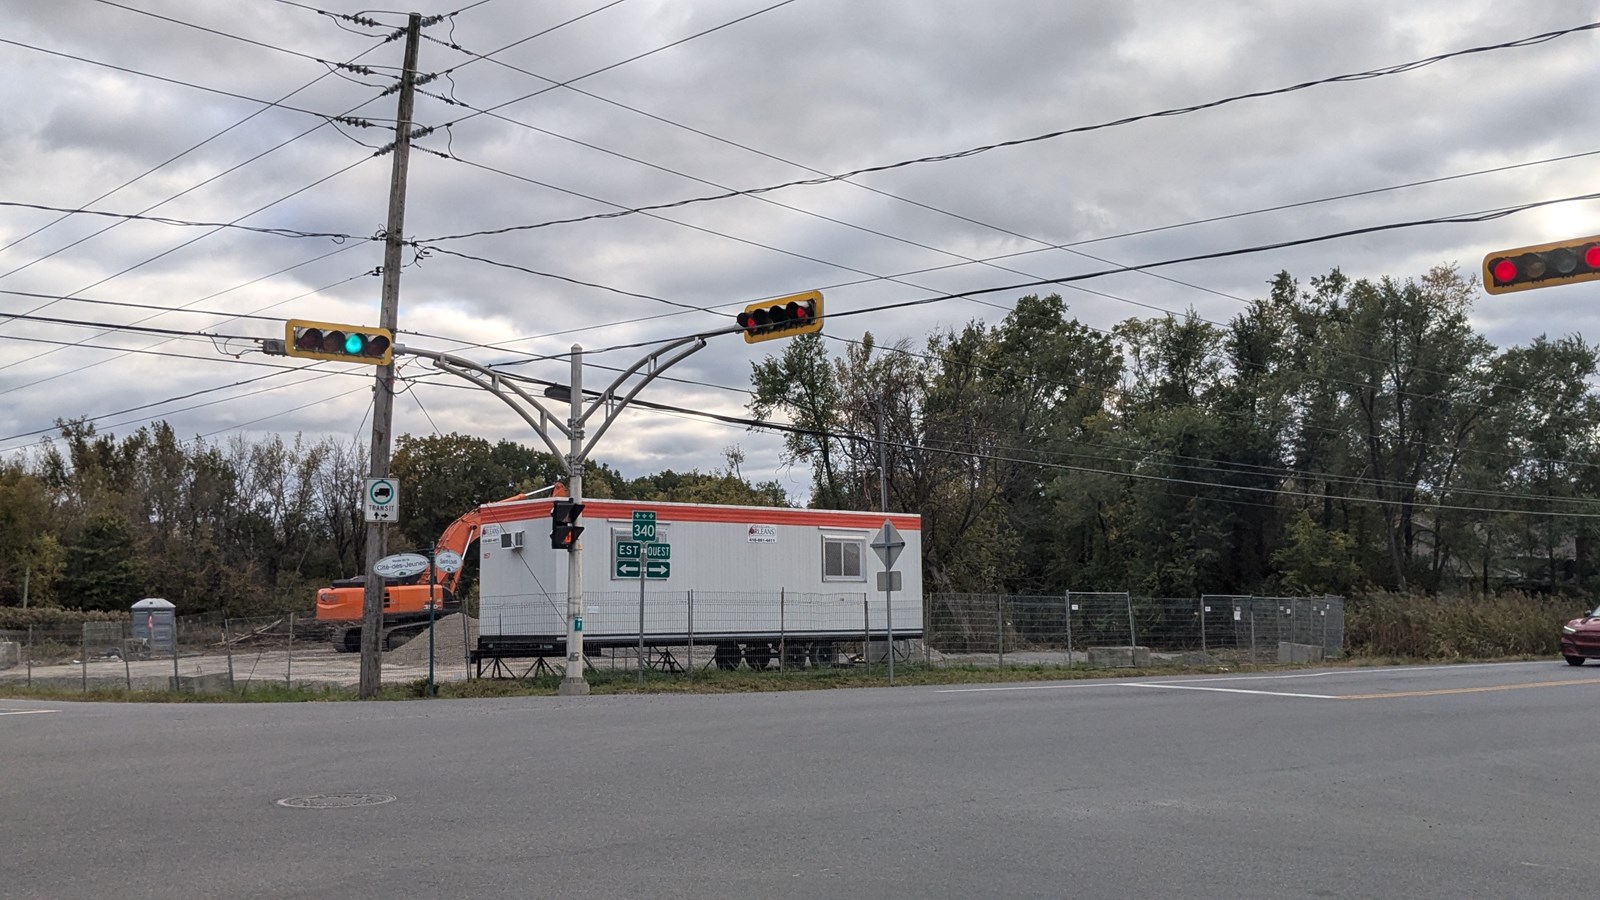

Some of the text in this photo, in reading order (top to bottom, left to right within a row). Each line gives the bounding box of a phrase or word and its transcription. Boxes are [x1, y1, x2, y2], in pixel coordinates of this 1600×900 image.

[369, 504, 394, 512] TRANSIT
[633, 524, 655, 537] 340
[619, 545, 639, 556] EST
[647, 546, 670, 557] OUEST
